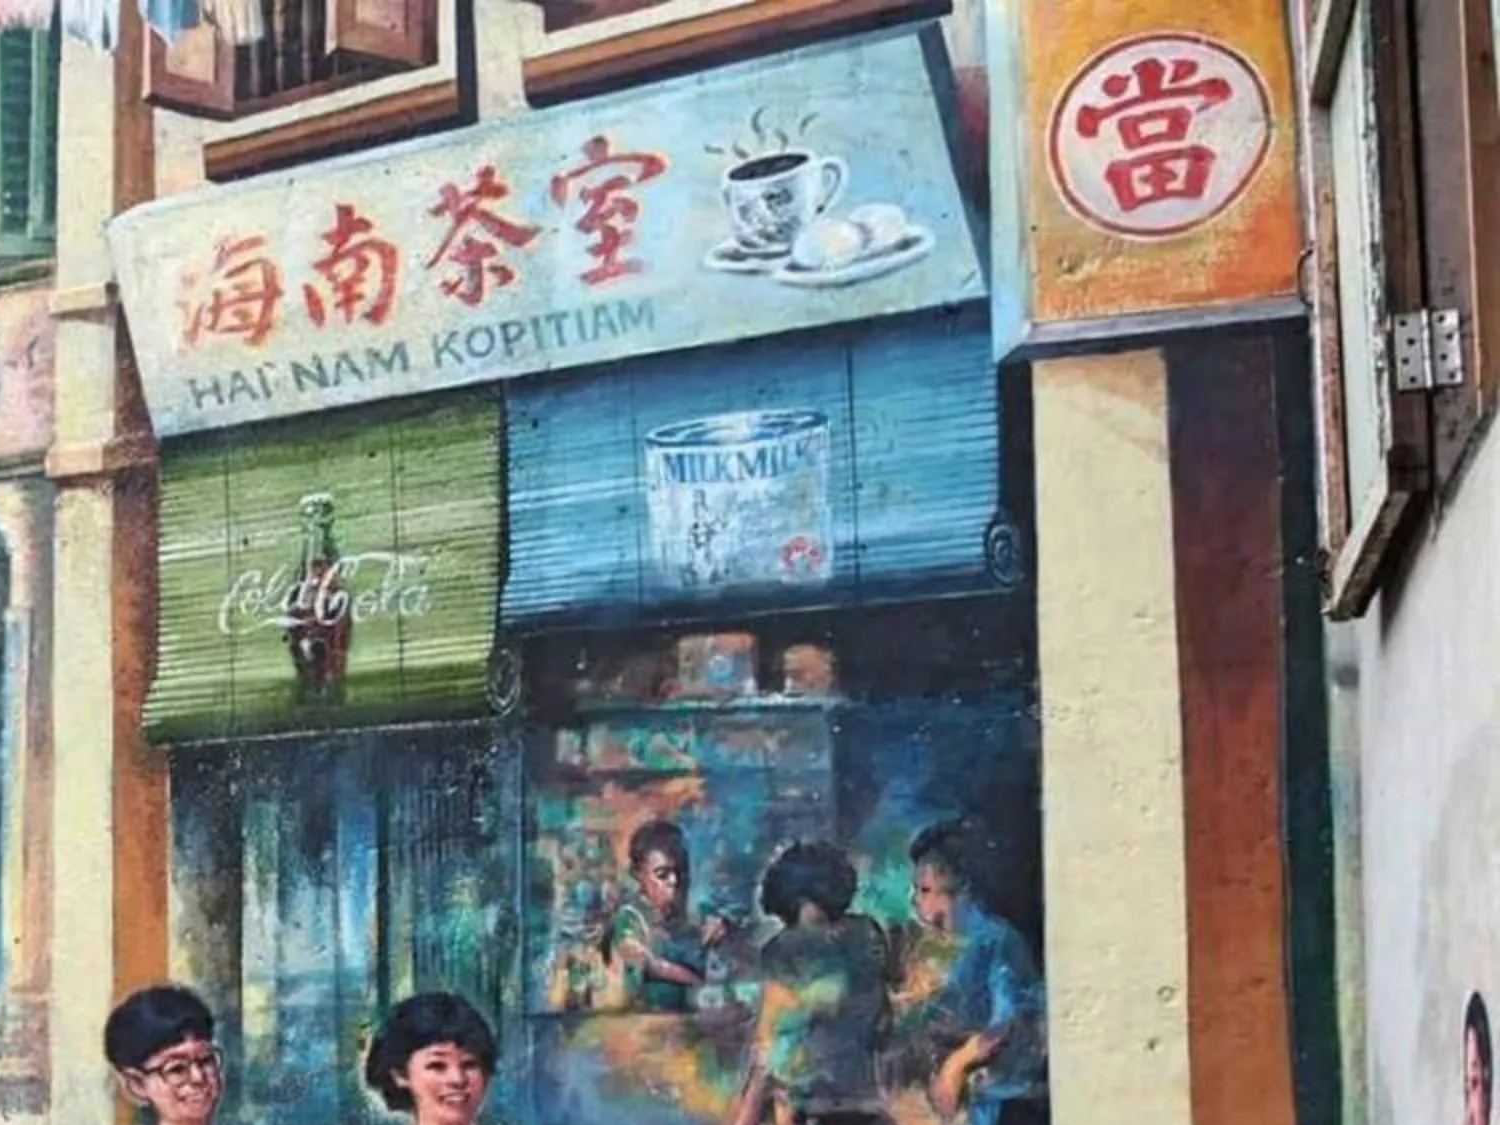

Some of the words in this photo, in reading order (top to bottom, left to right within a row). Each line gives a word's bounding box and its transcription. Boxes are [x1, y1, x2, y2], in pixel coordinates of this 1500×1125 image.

[1075, 57, 1233, 213] 當
[180, 136, 668, 352] 海南茶室
[430, 298, 655, 369] KOPITIAM
